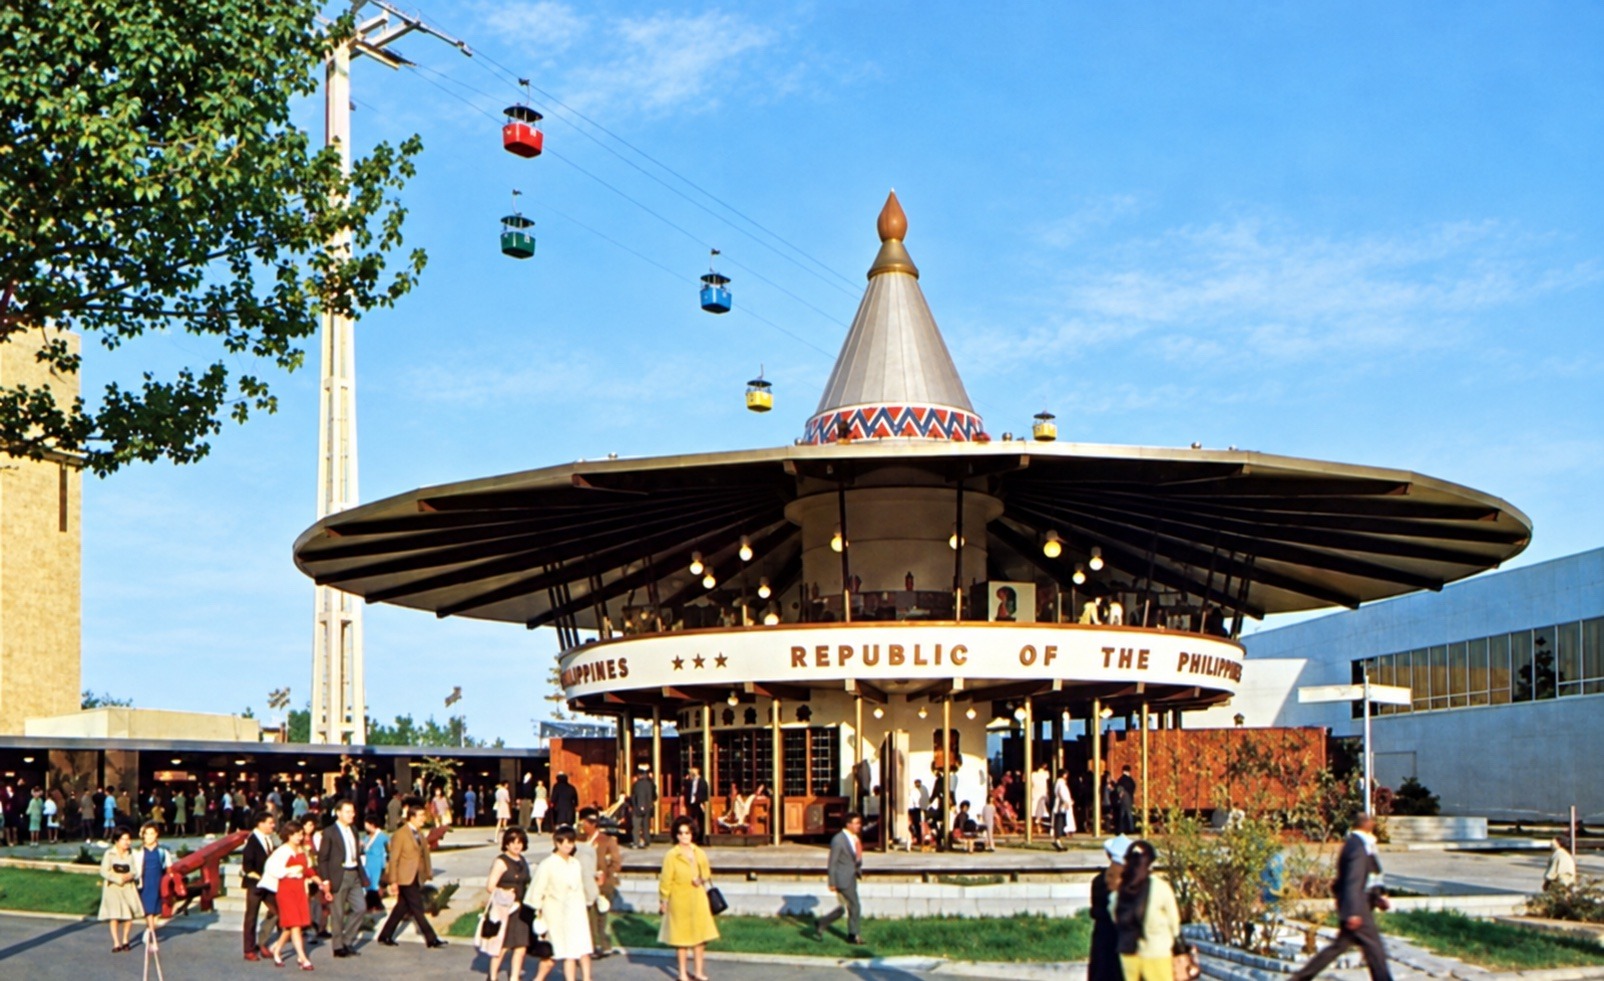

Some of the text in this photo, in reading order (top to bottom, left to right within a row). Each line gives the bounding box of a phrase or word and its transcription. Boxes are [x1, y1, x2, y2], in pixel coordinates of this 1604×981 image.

[790, 644, 968, 668] REPUBLIC
[1019, 644, 1058, 667] OF
[1101, 647, 1150, 670] THE
[561, 657, 629, 690] LIPPINES
